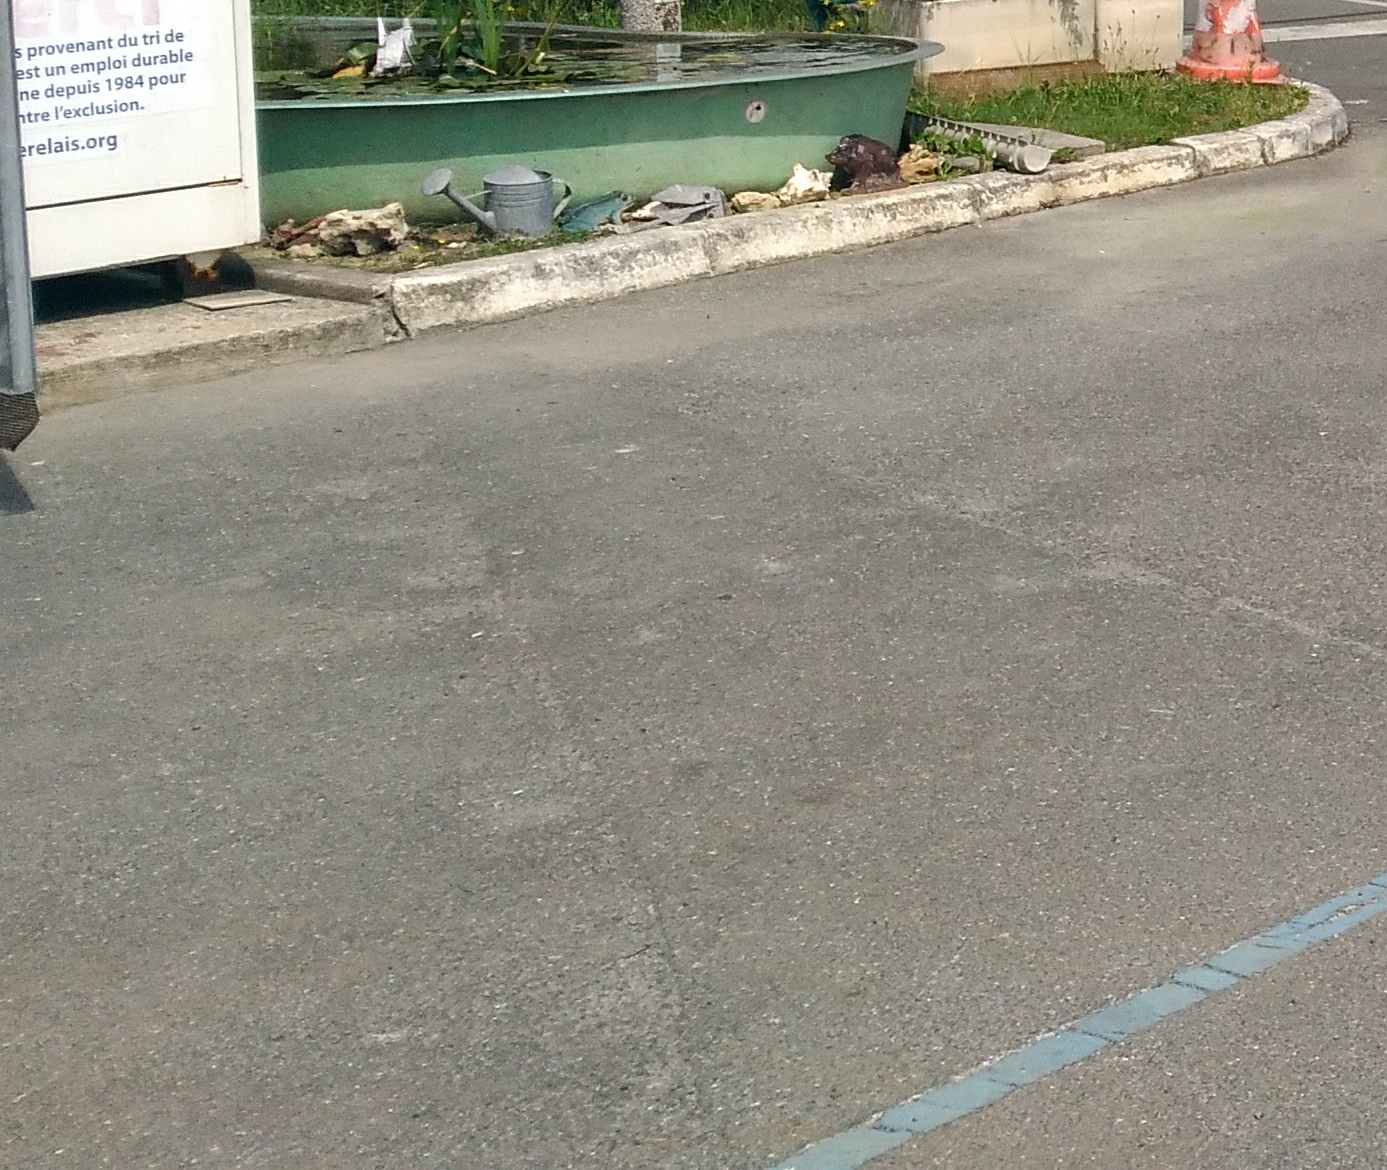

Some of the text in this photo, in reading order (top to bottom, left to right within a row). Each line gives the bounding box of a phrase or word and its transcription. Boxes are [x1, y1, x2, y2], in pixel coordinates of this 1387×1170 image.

[27, 37, 114, 60] provenant
[117, 34, 138, 48] du
[142, 30, 160, 45] tri
[164, 28, 185, 43] de
[45, 65, 66, 78] un
[70, 54, 128, 76] emploi
[132, 49, 194, 68] durable
[19, 71, 187, 101] ne depuis 1984 pour
